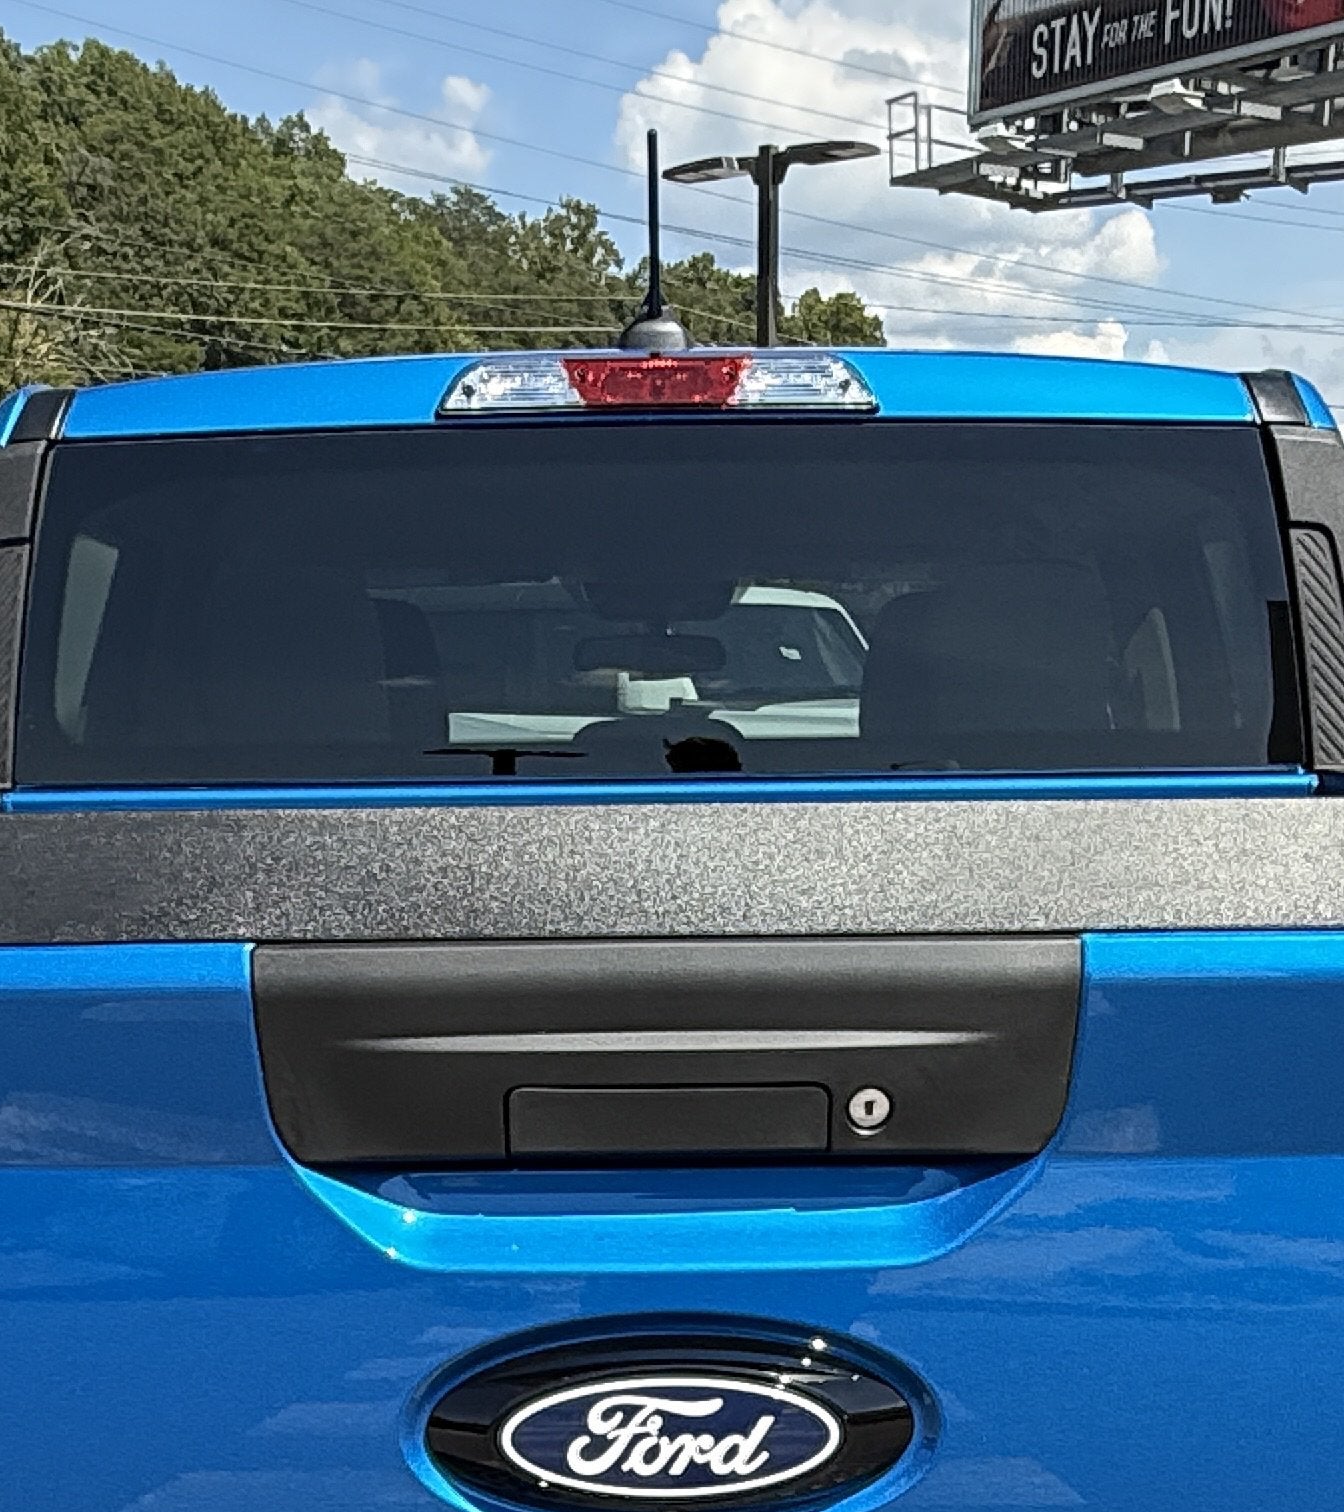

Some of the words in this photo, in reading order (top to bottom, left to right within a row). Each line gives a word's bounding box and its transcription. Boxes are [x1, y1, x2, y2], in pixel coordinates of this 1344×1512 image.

[1032, 6, 1102, 79] STAY
[1101, 18, 1128, 49] FOR
[1131, 10, 1157, 42] THE
[1164, 0, 1233, 45] FUN!
[566, 1394, 775, 1476] Ford
